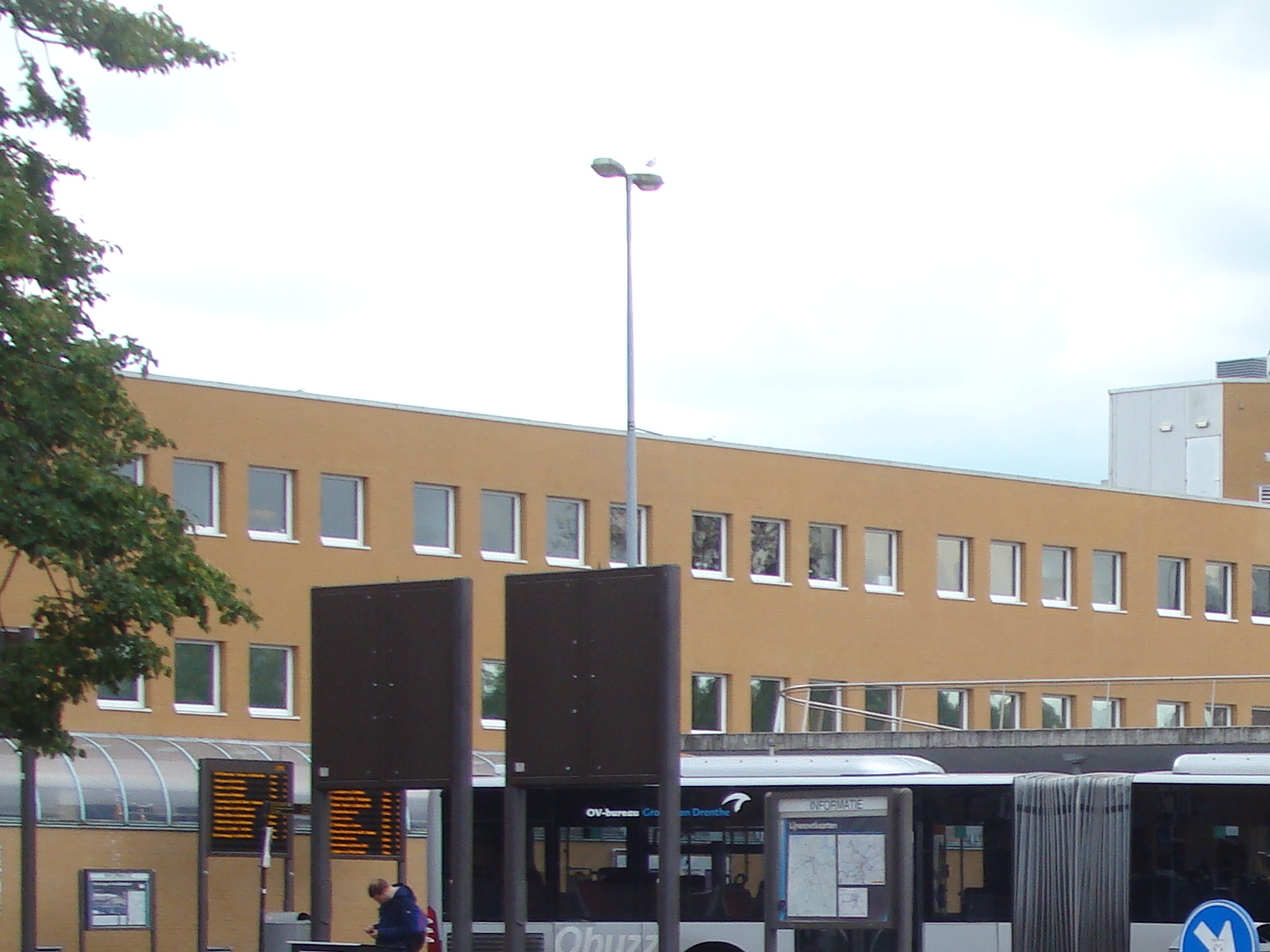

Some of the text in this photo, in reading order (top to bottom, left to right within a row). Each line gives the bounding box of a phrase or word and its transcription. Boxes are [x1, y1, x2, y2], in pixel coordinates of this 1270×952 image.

[809, 799, 864, 811] INFORMATIE
[585, 807, 640, 818] OV-bureau
[692, 807, 731, 818] Drenthe
